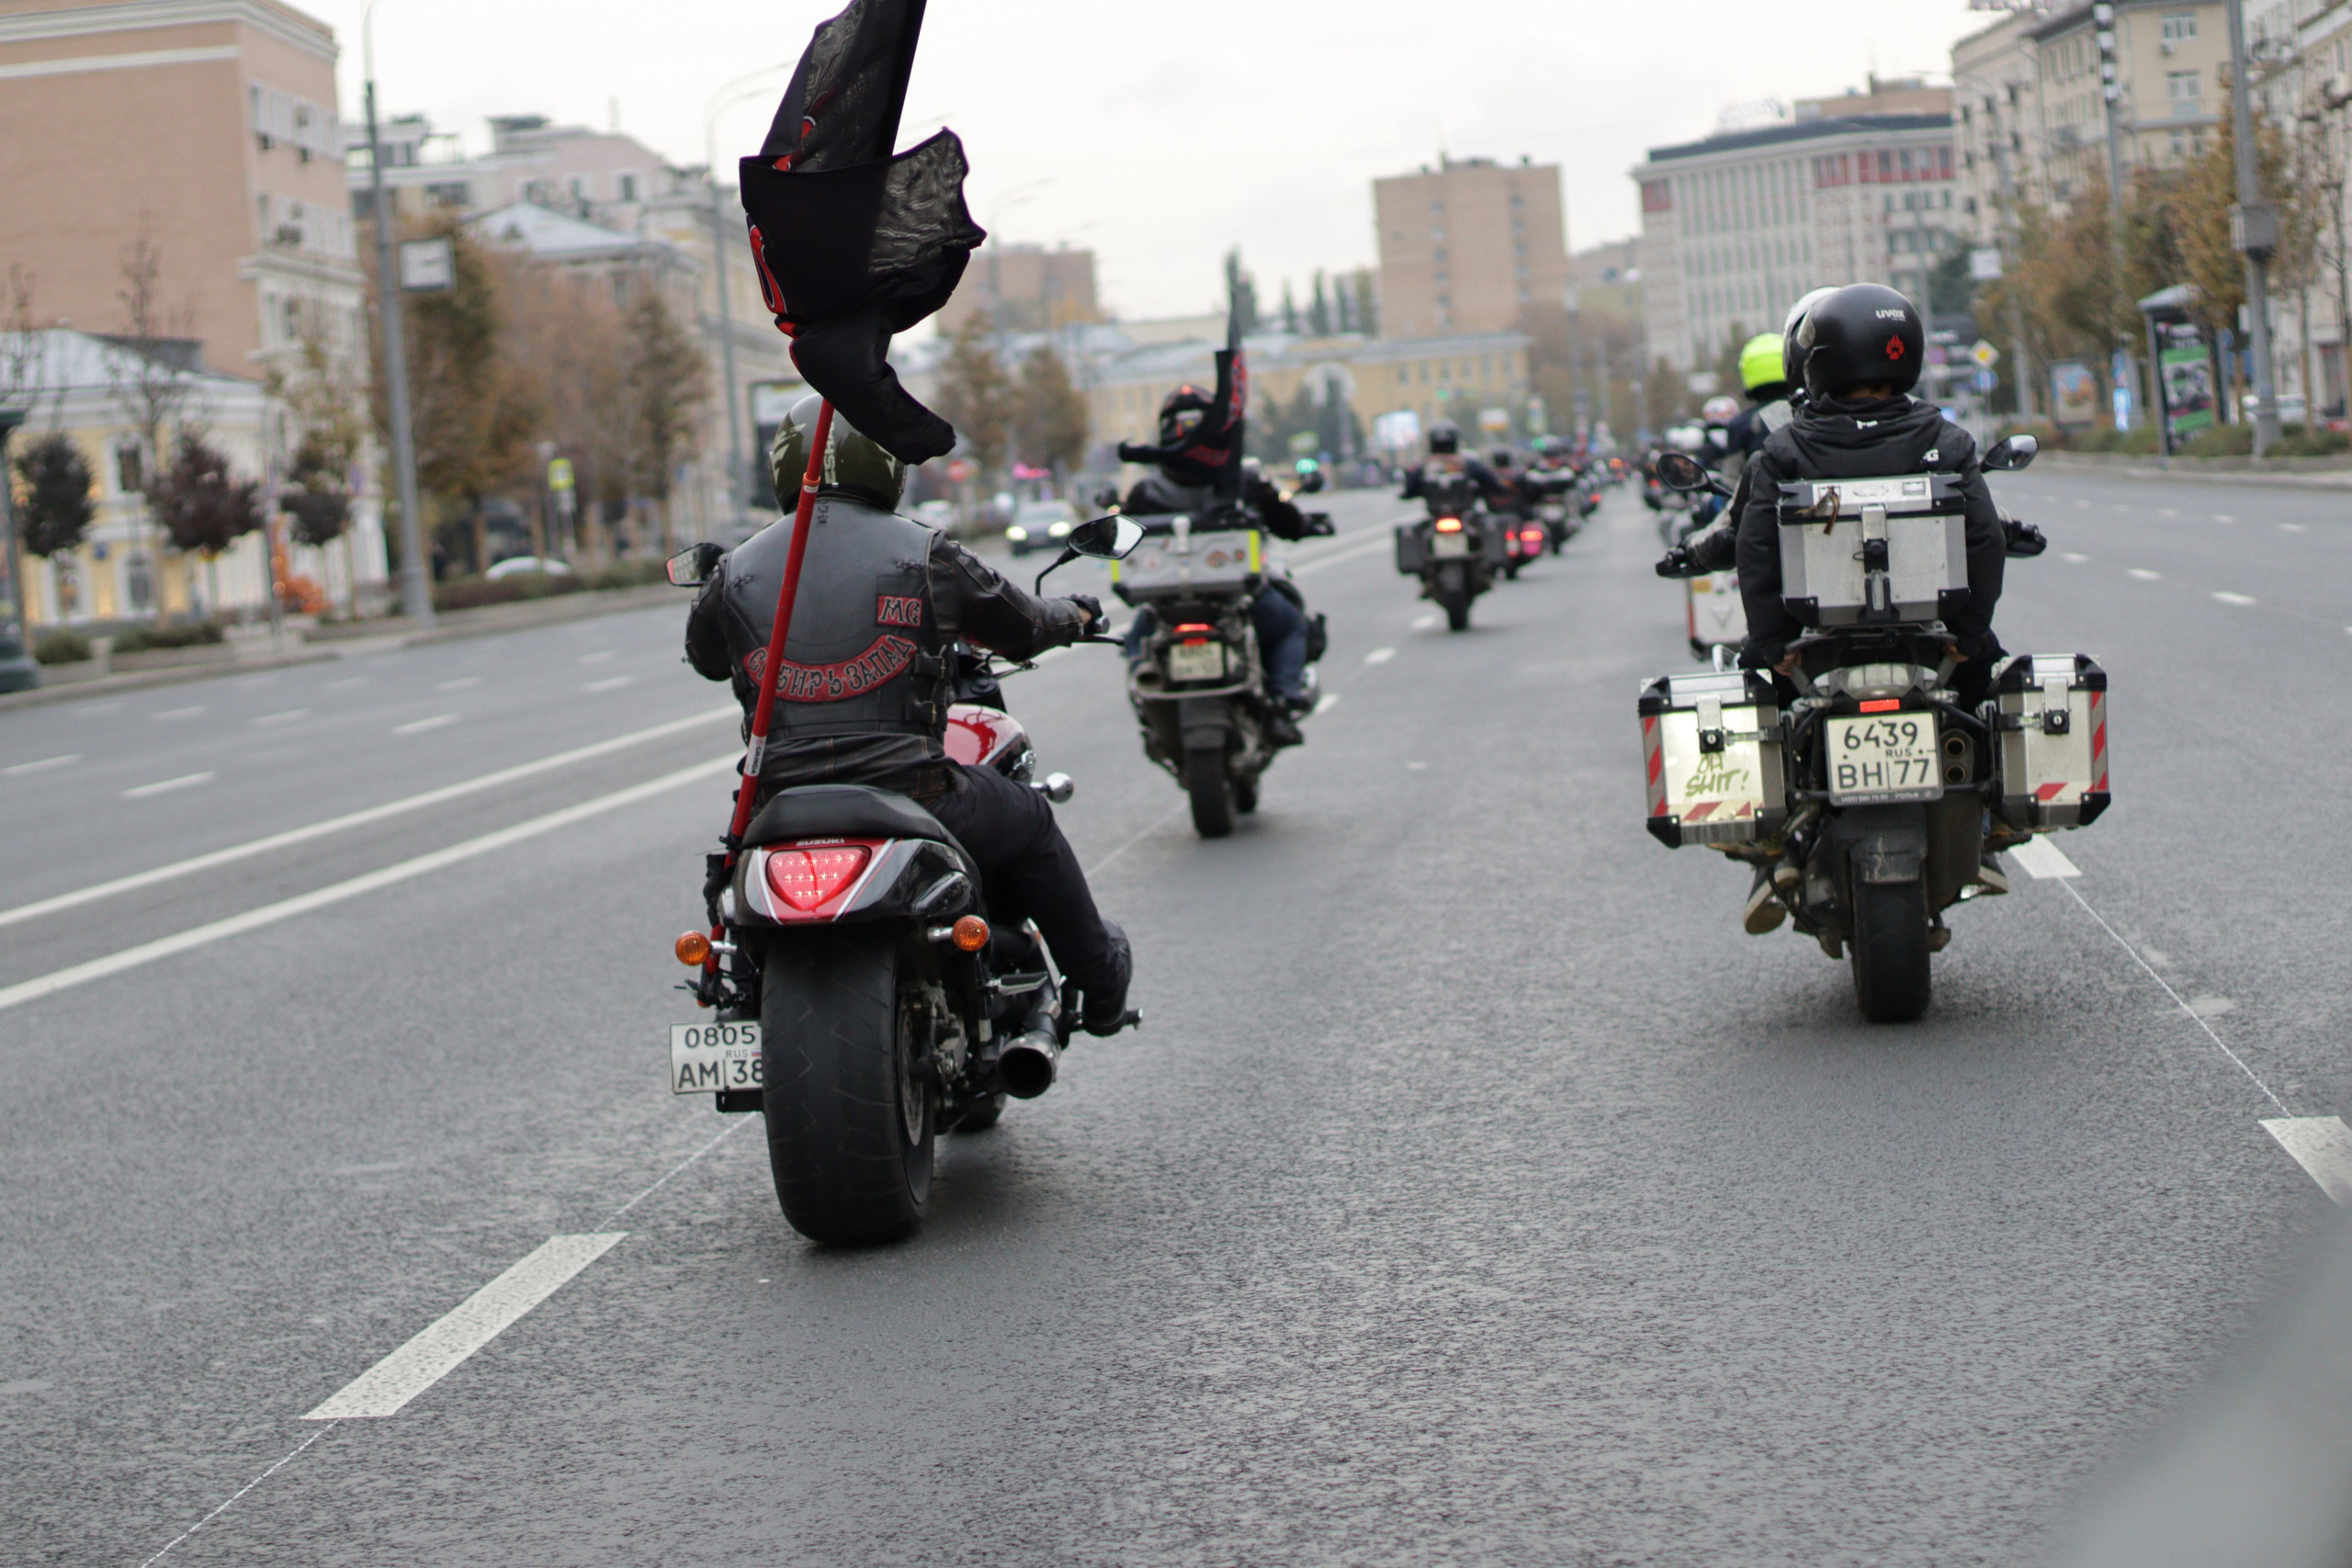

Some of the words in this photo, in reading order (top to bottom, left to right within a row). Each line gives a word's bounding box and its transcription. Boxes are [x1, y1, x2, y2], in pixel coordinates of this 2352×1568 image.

[1875, 308, 1905, 319] uvex
[1844, 721, 1918, 750] 6439
[1885, 749, 1912, 758] RUS
[1894, 758, 1930, 785] 77
[796, 838, 845, 847] SUZUKI
[684, 1025, 755, 1049] 0805
[726, 1050, 749, 1058] RUS
